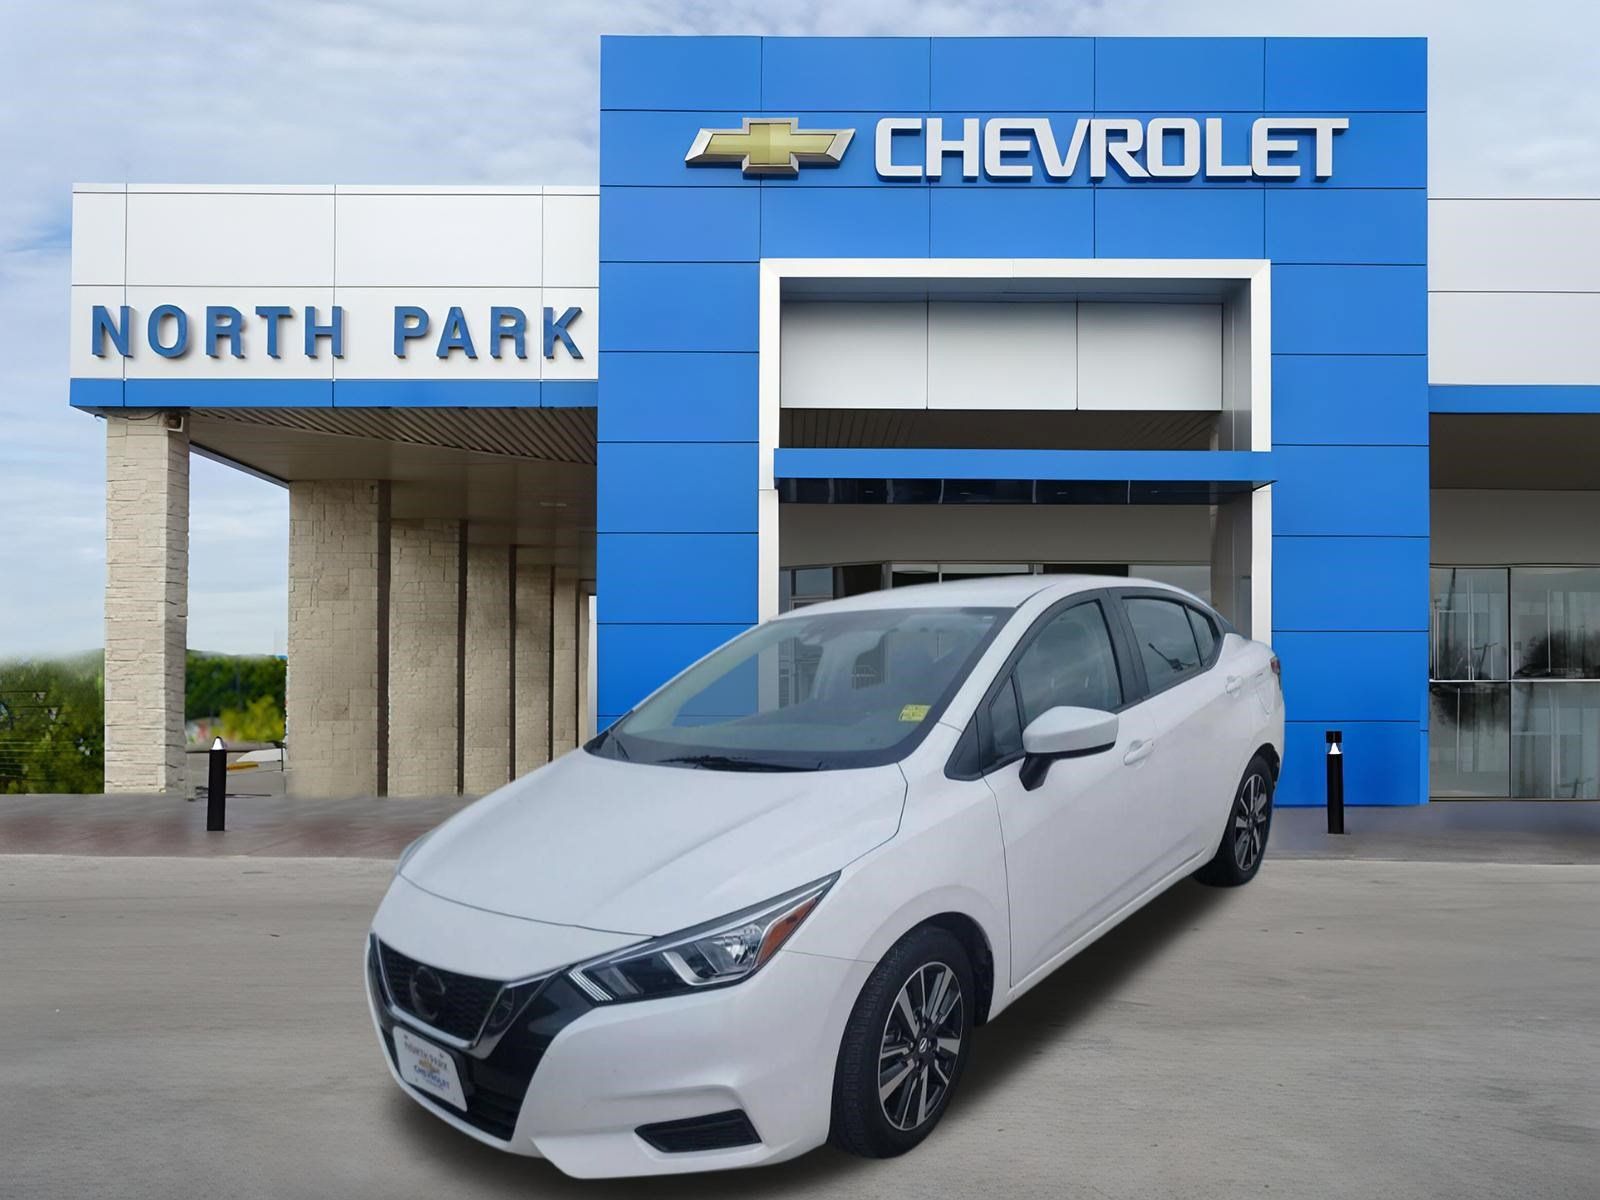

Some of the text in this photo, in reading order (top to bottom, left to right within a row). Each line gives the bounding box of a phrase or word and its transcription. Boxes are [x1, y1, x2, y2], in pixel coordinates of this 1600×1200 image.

[875, 116, 1350, 178] CHEVROLET
[92, 304, 585, 360] NORTH PARK
